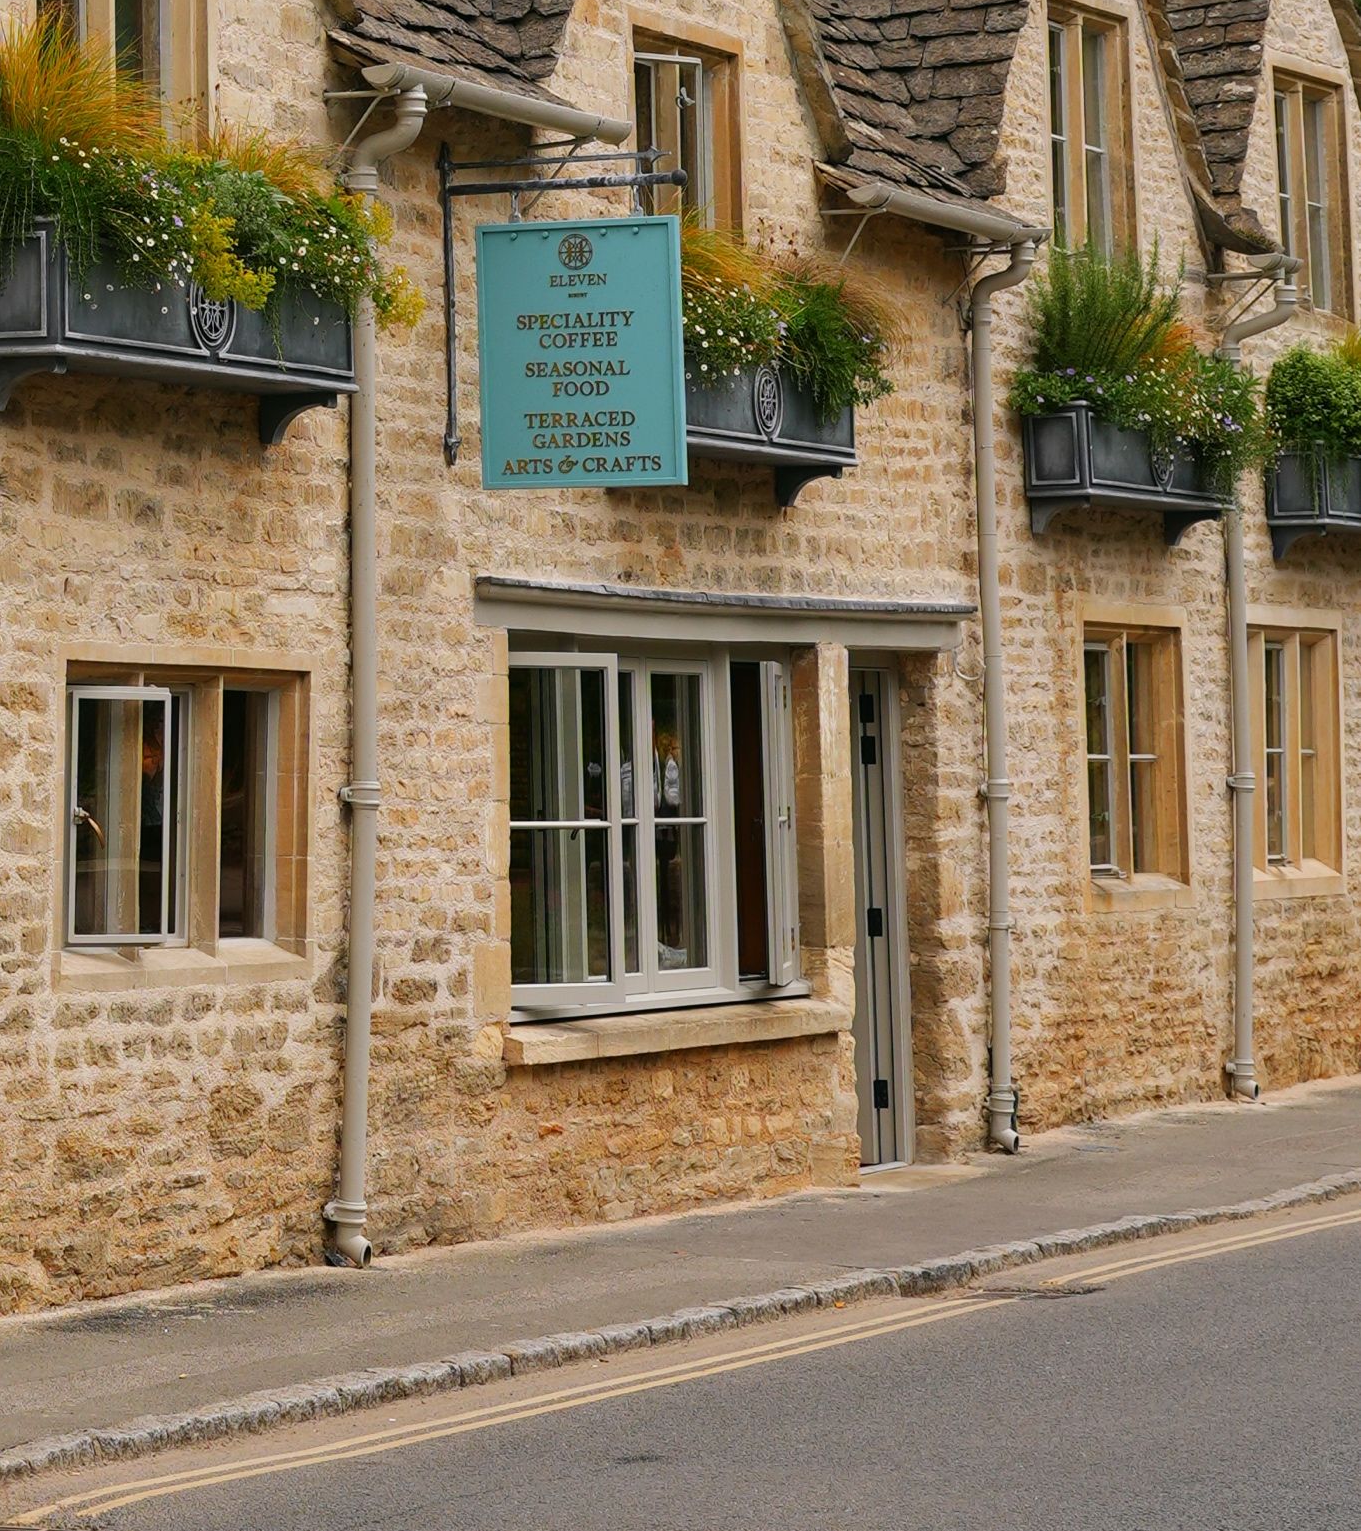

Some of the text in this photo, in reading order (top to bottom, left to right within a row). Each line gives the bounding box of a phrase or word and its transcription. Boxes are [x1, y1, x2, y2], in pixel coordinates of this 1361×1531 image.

[549, 273, 608, 288] ELEVEN
[516, 310, 635, 330] SPECIALITY
[539, 331, 618, 349] COFFEE
[525, 360, 631, 378] SEASONAL
[552, 380, 610, 398] FOOD
[524, 410, 636, 429] TERRACED
[532, 430, 631, 449] GARDENS
[501, 454, 662, 476] ARTS & CRAFTS
